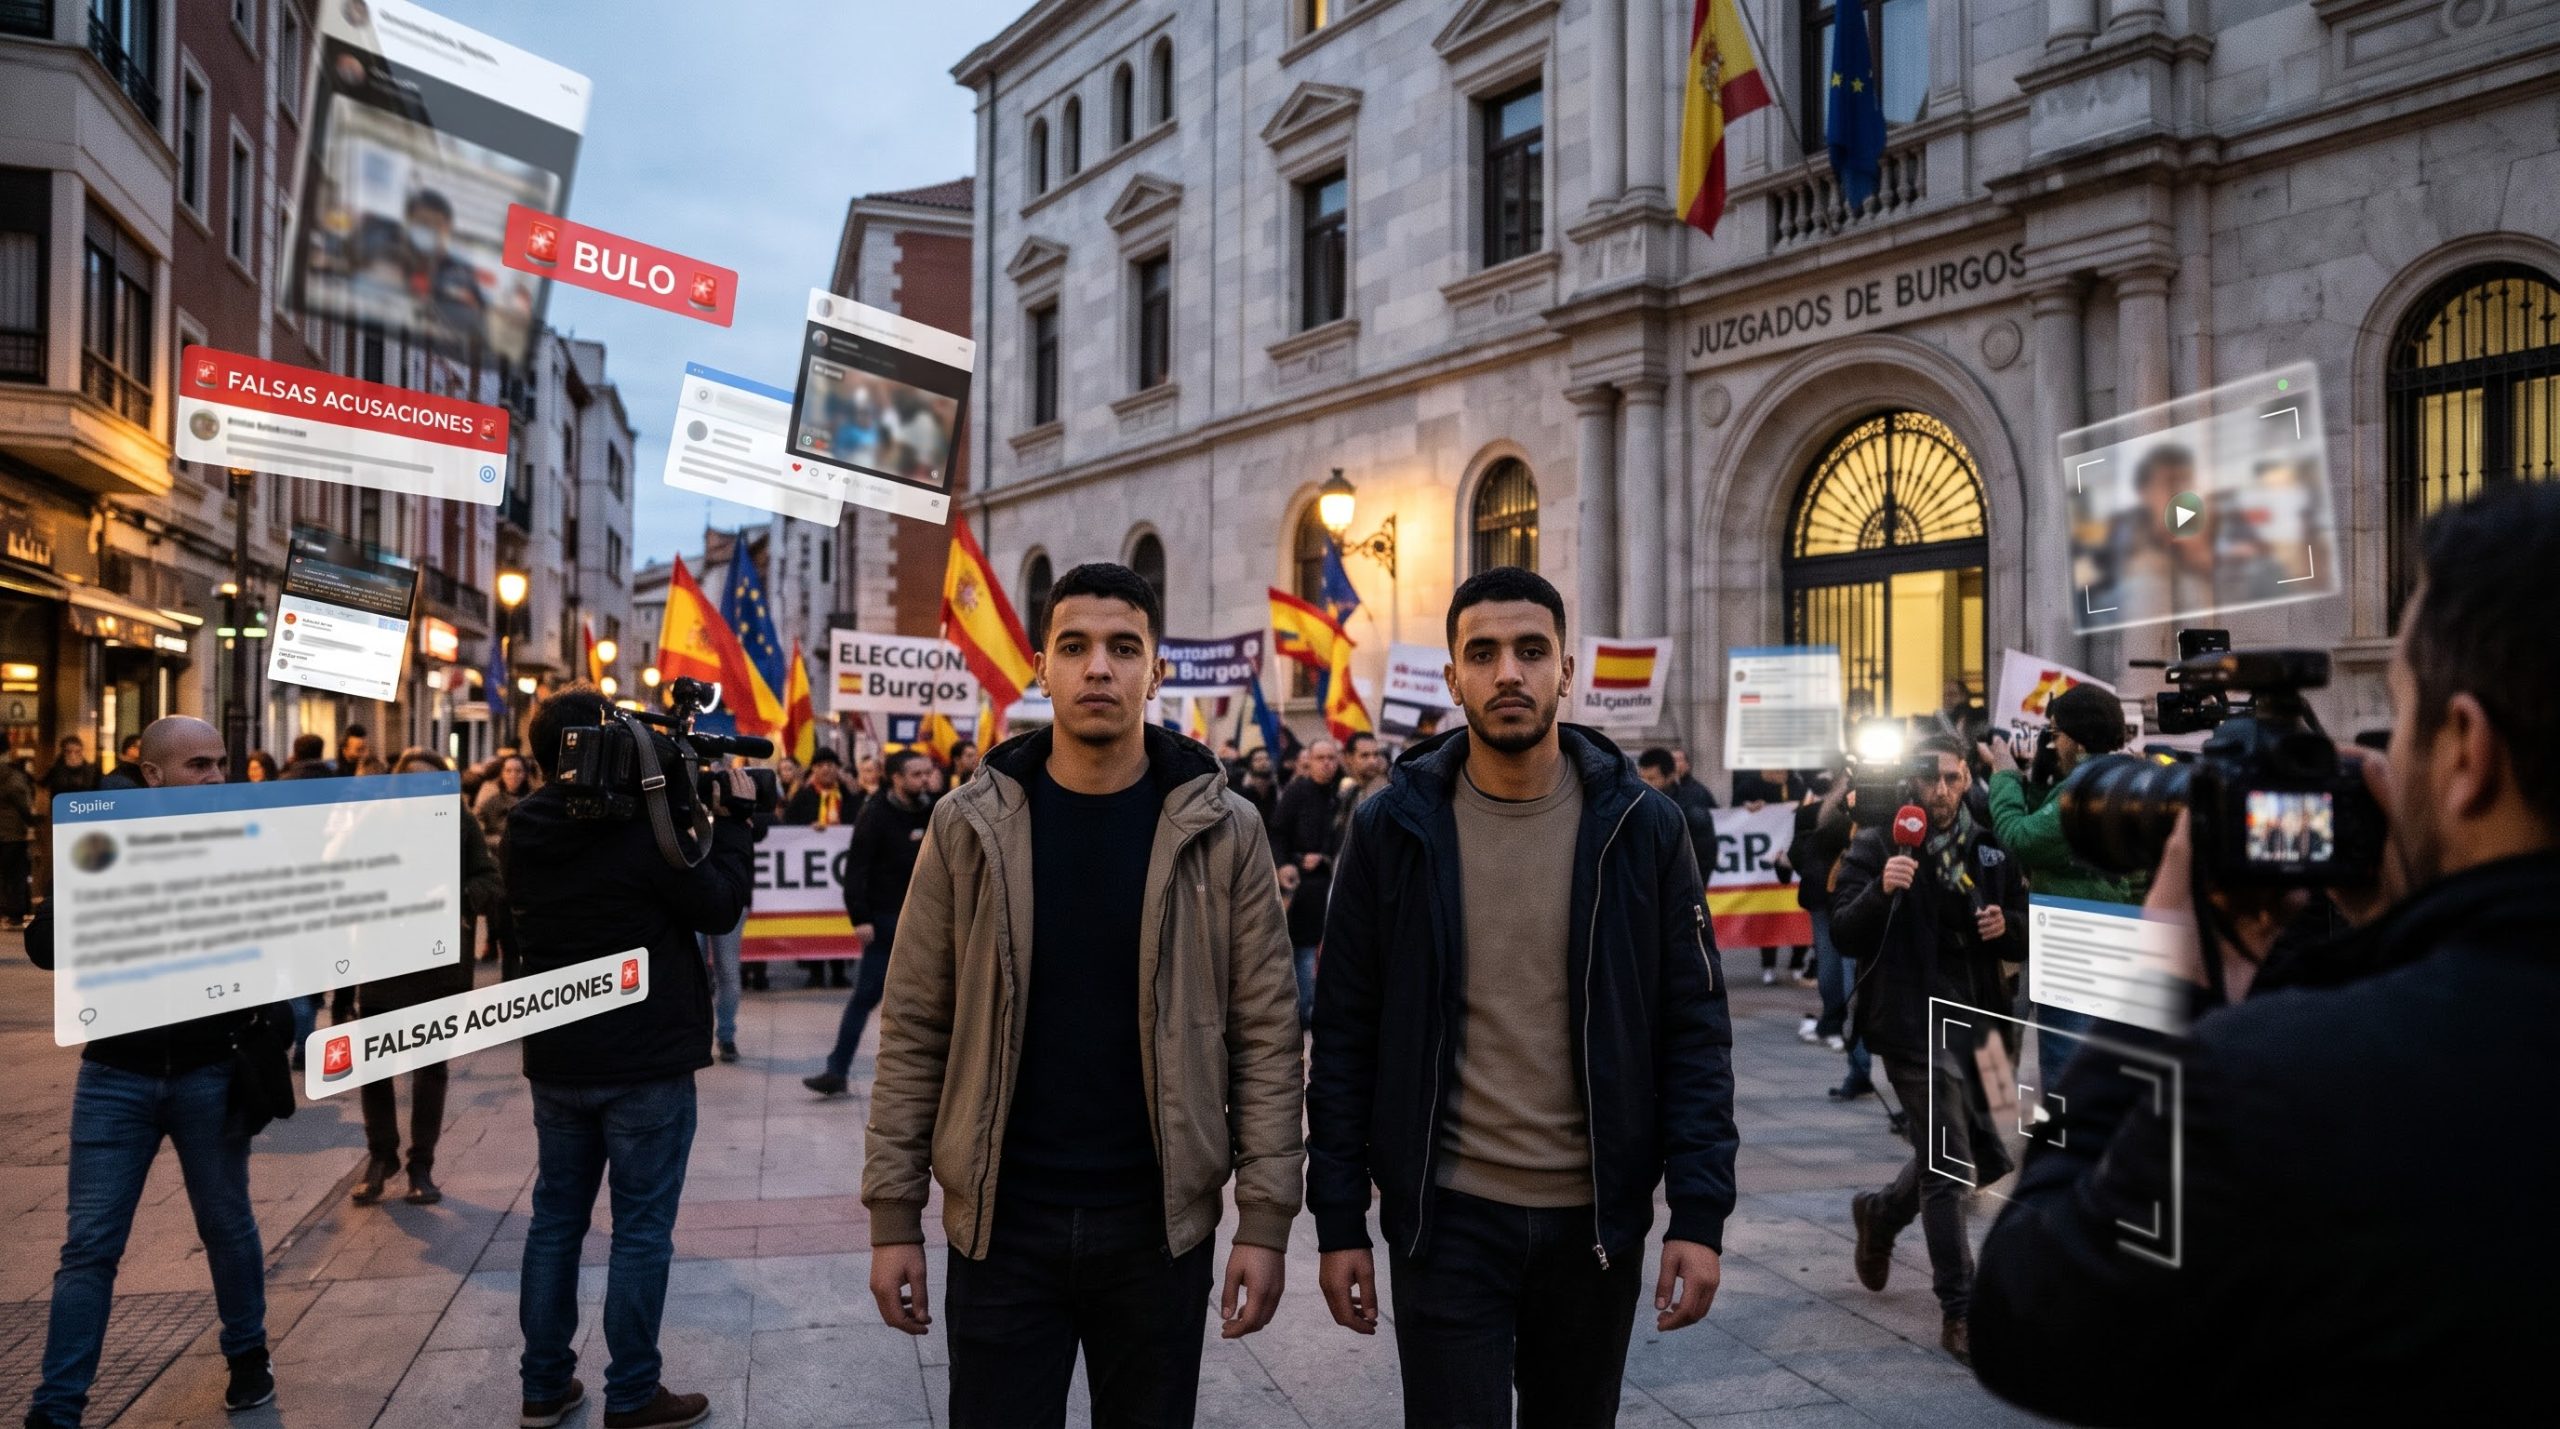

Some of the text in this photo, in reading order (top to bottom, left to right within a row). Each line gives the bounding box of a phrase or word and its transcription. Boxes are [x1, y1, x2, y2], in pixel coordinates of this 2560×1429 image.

[1691, 242, 2027, 359] JUZGADOS DE BURGOS
[839, 643, 971, 671] ELECCION
[1180, 661, 1253, 684] Burgos
[868, 672, 968, 706] Burgos
